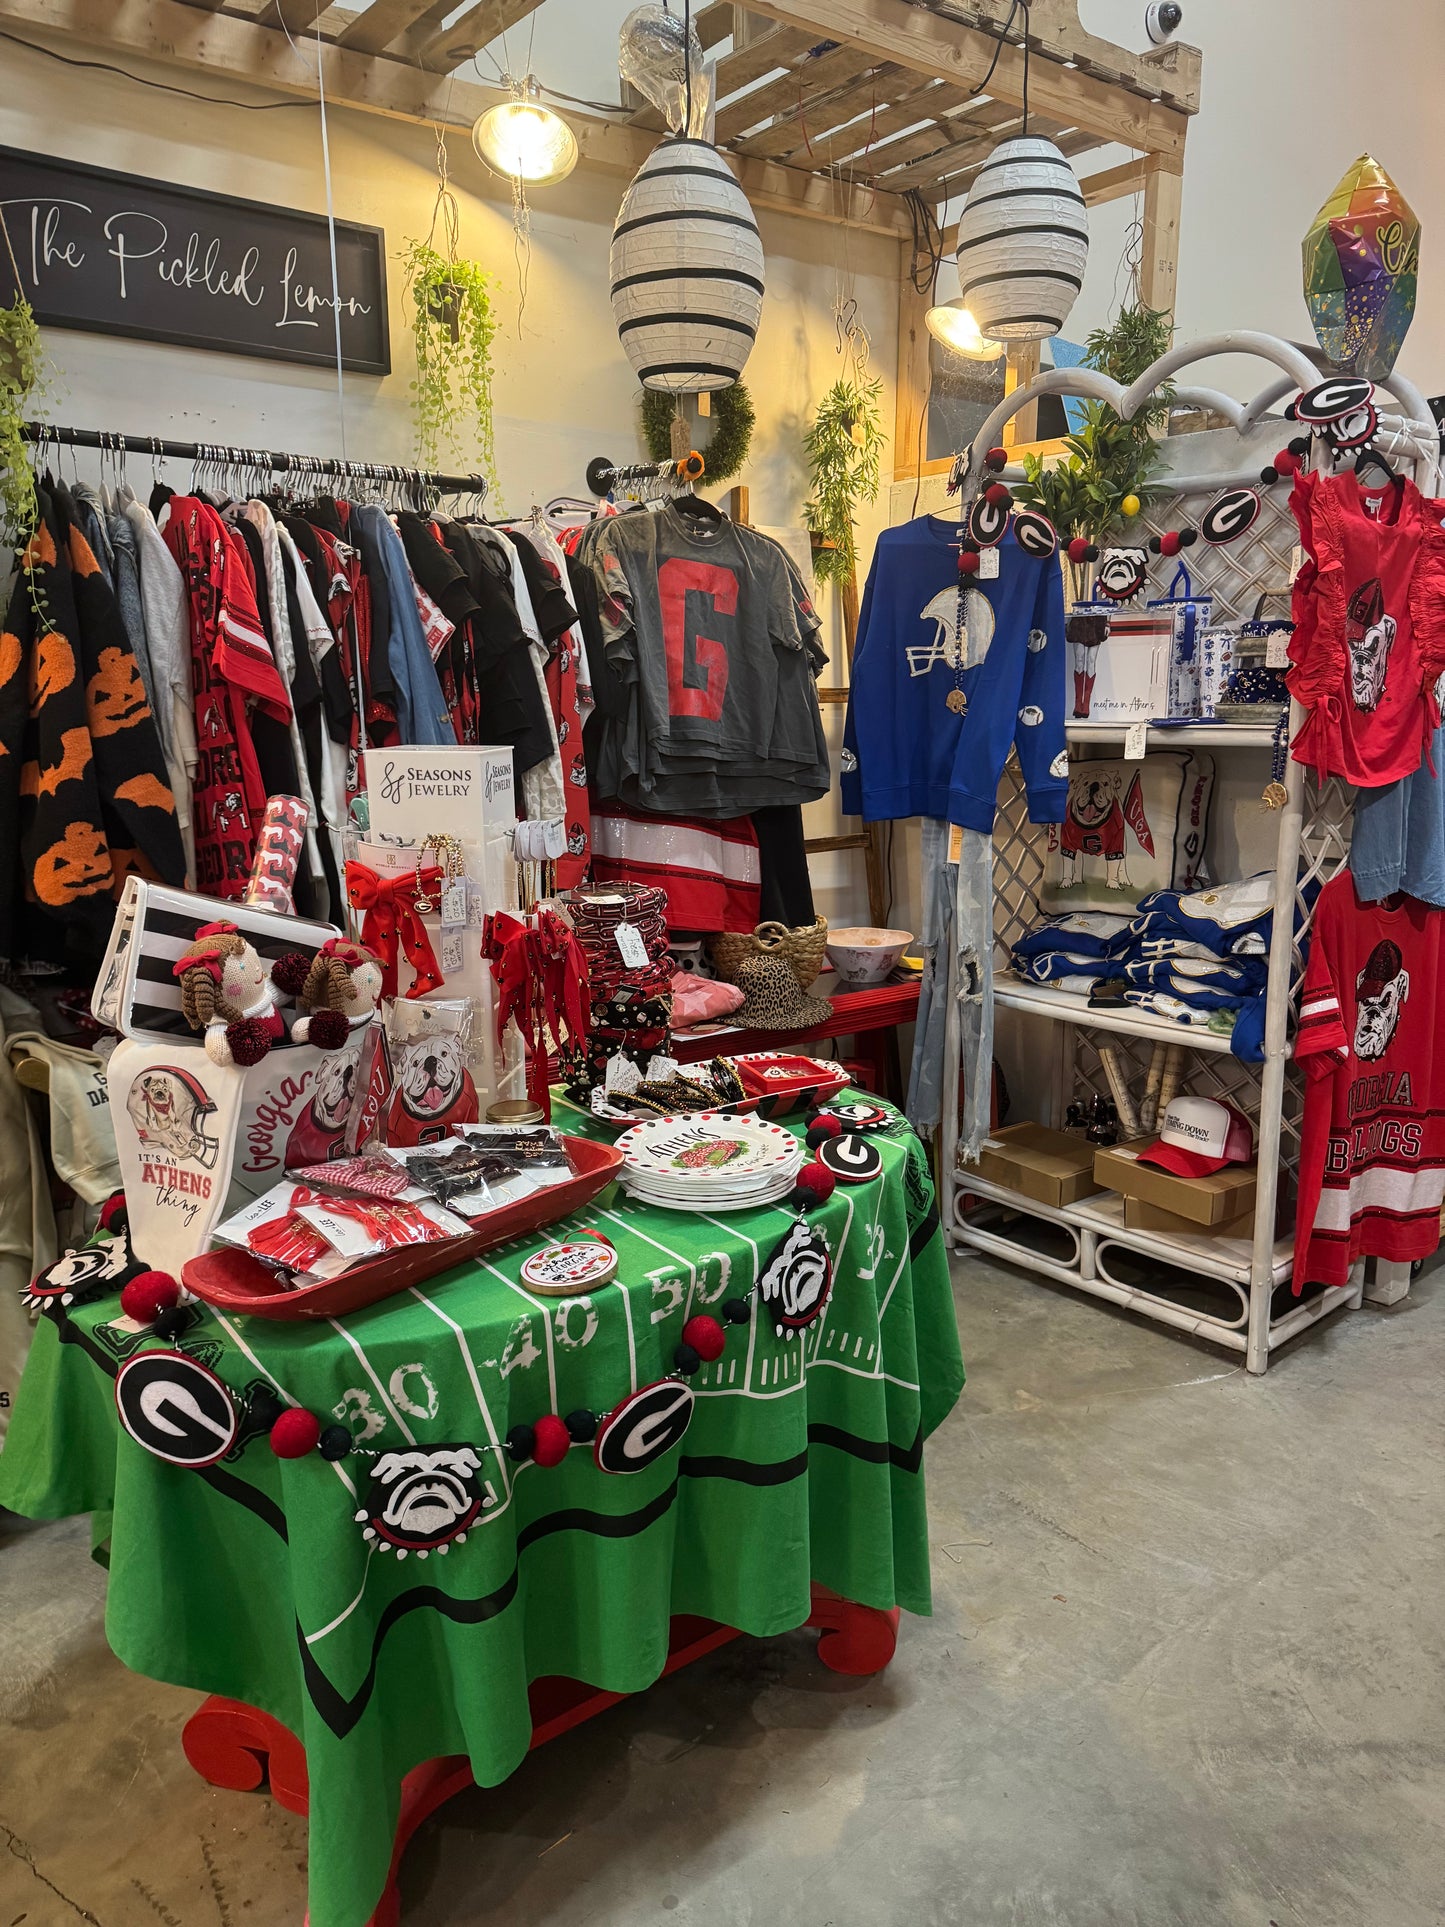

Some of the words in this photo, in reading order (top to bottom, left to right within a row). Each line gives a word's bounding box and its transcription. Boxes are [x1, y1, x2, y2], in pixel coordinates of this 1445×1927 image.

[0, 197, 92, 286] The
[103, 211, 264, 306] Pickled
[275, 247, 371, 327] Lemon
[658, 557, 739, 722] G
[1093, 698, 1110, 710] meet
[1129, 696, 1155, 712] Athens
[407, 767, 472, 782] SEASONS
[408, 782, 470, 799] JEWELRY
[1130, 798, 1150, 845] UGA
[1082, 835, 1103, 852] G
[242, 1070, 313, 1173] Georgia
[1184, 1124, 1209, 1138] DOWN
[645, 1126, 721, 1159] ATHENS
[138, 1153, 161, 1164] IT'S
[166, 1157, 178, 1167] AN
[141, 1162, 212, 1200] ATHENS
[155, 1185, 201, 1227] thing
[542, 1251, 587, 1272] athens
[550, 1255, 588, 1273] GEORGIA
[643, 1251, 732, 1324] 50
